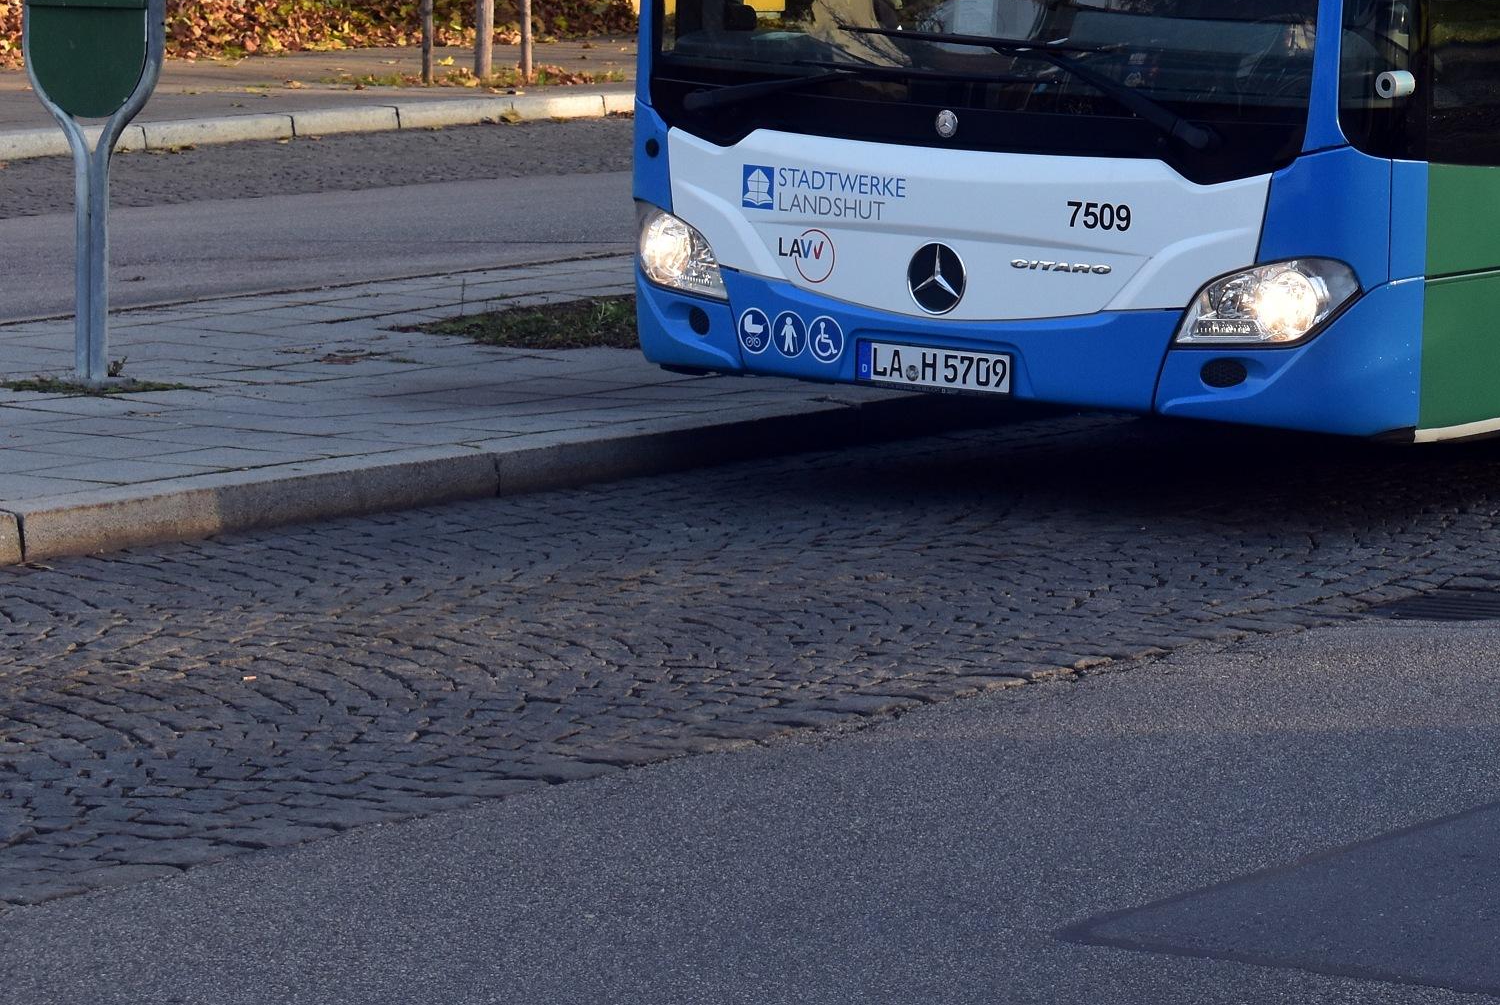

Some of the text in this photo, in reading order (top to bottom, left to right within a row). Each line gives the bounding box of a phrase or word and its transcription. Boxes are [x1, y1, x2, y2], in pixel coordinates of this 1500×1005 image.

[778, 167, 907, 198] STADTWERKE
[778, 192, 886, 221] LANDSHUT
[1066, 200, 1132, 232] 7509
[1010, 259, 1112, 275] CITARO
[873, 347, 903, 378] LA
[921, 352, 937, 382] H
[944, 354, 1007, 388] 5709
